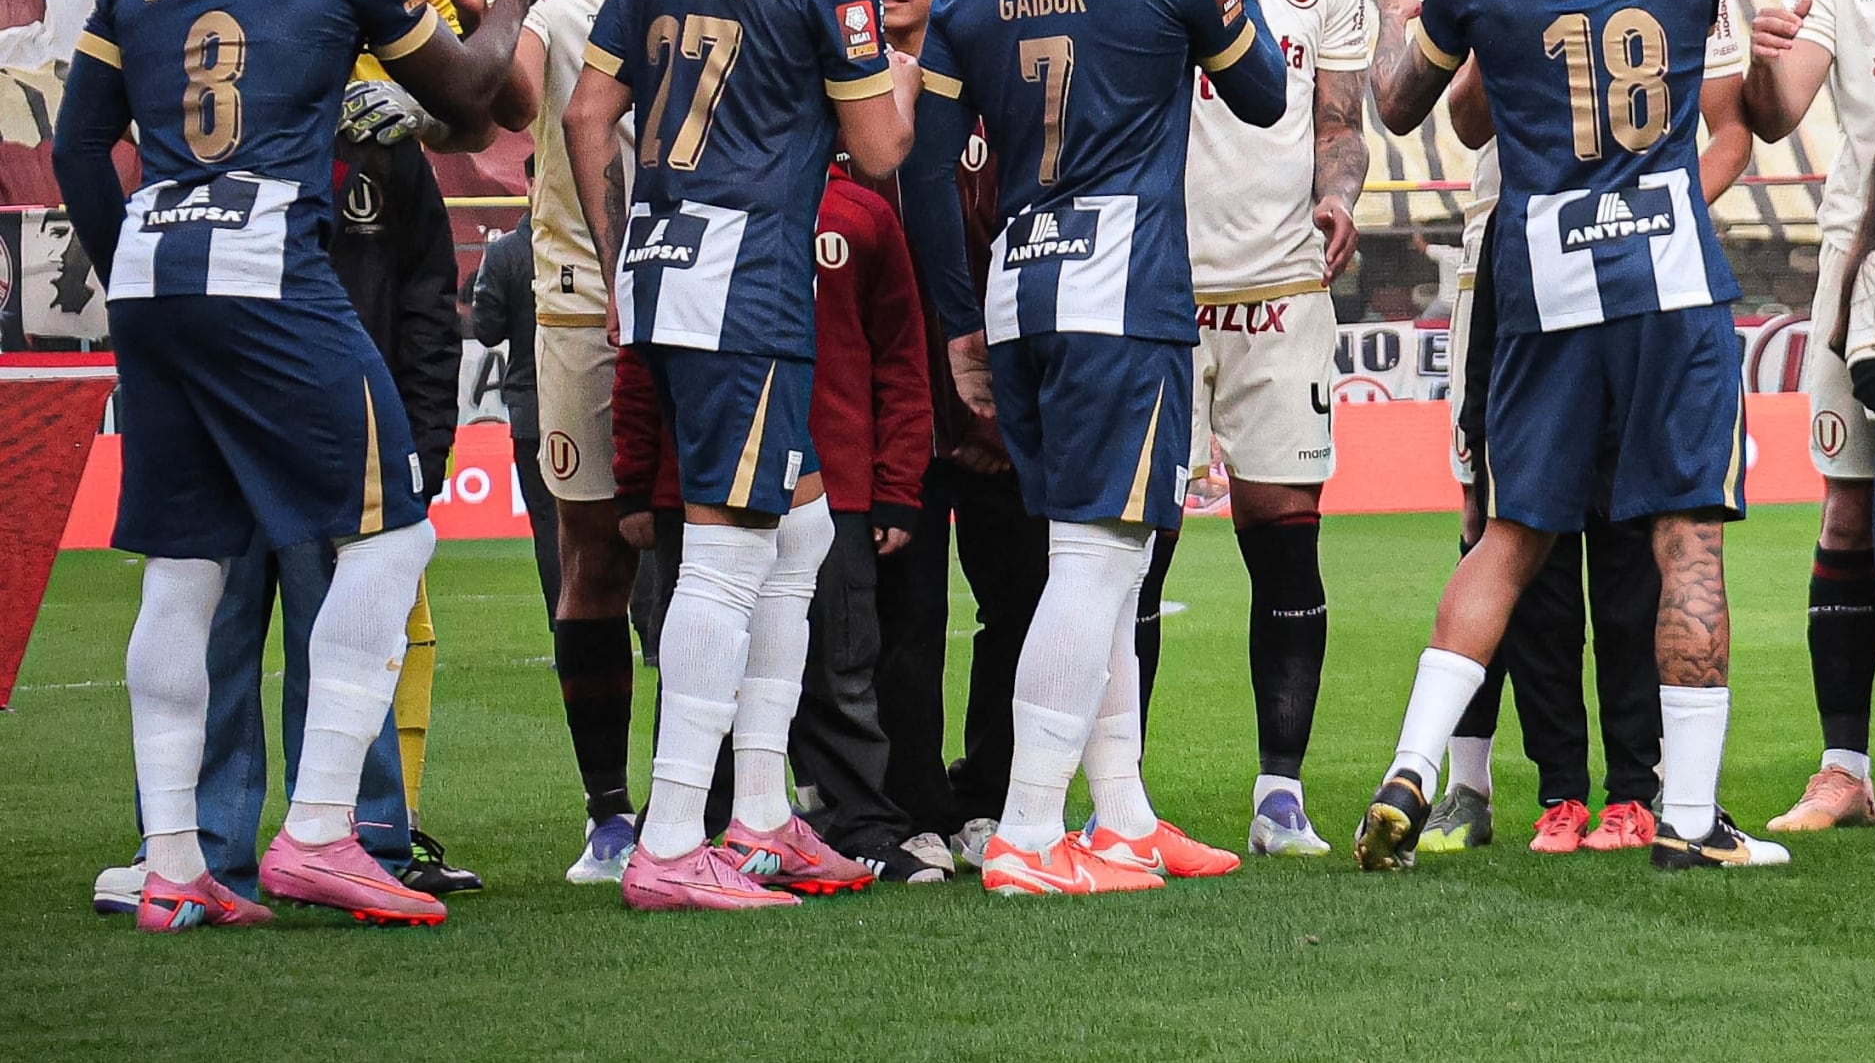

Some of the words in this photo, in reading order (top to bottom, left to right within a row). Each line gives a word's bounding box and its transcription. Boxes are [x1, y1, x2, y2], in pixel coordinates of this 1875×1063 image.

[182, 9, 246, 164] 8
[642, 13, 742, 171] 27
[1018, 34, 1075, 187] 7
[1542, 7, 1671, 162] 18
[147, 203, 241, 227] ANYPSA
[626, 244, 690, 264] ANYPSA
[1008, 235, 1088, 265] ANYPSA
[1565, 214, 1669, 245] ANYPSA
